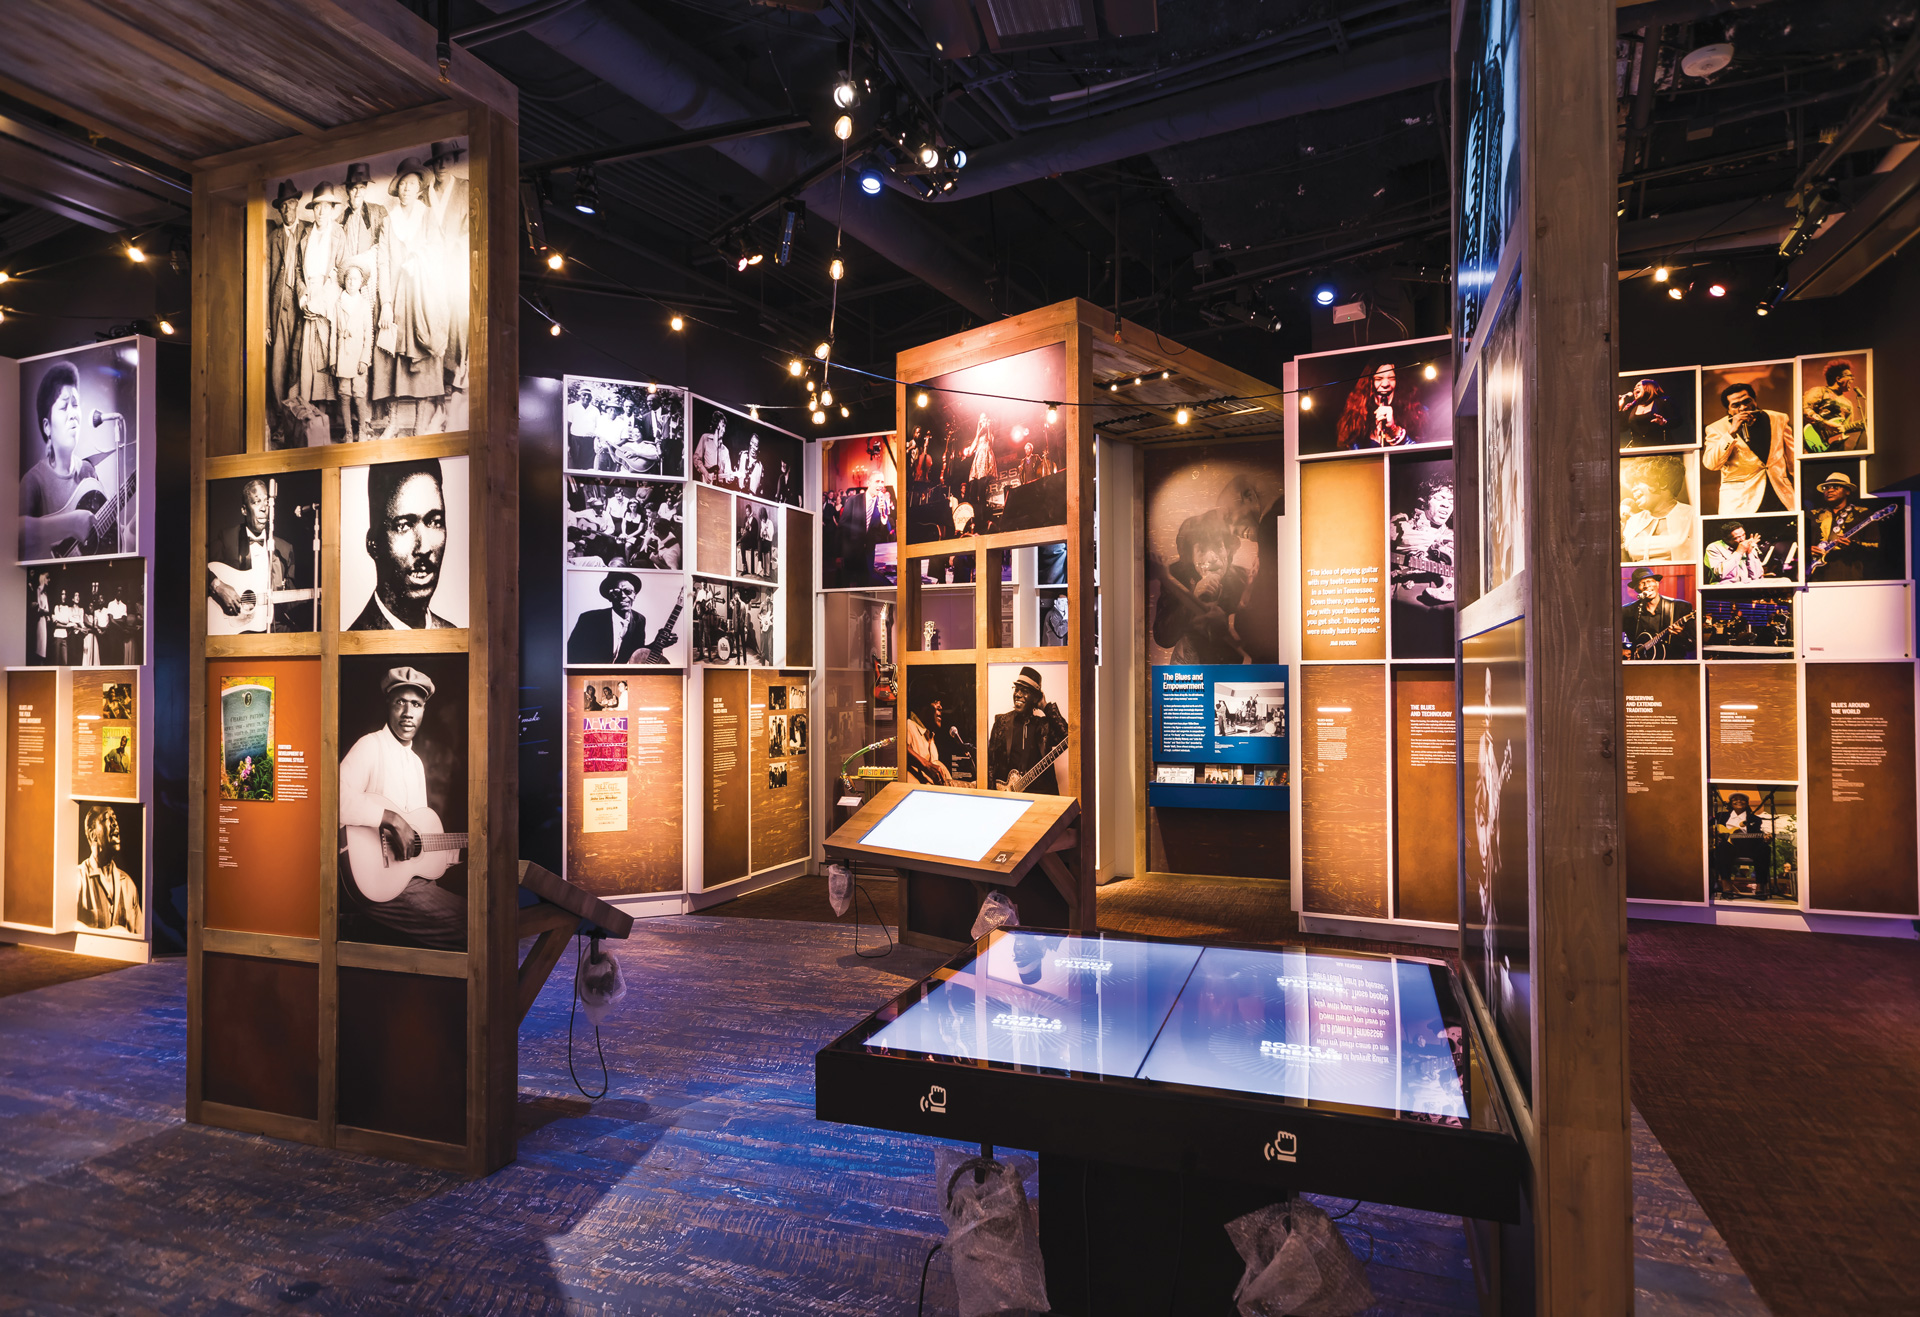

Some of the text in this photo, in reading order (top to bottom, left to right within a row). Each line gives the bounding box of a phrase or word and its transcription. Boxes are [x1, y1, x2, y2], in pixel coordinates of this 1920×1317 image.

[1307, 568, 1320, 576] "The
[1333, 567, 1340, 575] of
[1340, 567, 1361, 576] playing
[1361, 566, 1379, 575] guitar
[1307, 578, 1320, 586] with
[1320, 579, 1329, 587] my
[1330, 577, 1345, 585] teeth
[1311, 588, 1317, 596] in
[1343, 586, 1375, 594] Tennessee.
[1326, 597, 1344, 605] there,
[1343, 597, 1355, 606] you
[1355, 596, 1369, 604] have
[1369, 595, 1376, 603] to
[1306, 608, 1318, 617] play
[1318, 607, 1331, 615] with
[1331, 607, 1345, 616] your
[1345, 606, 1361, 614] teeth
[1368, 605, 1380, 613] else
[1307, 615, 1380, 627] you get shot. Those people
[1320, 627, 1337, 636] really
[1336, 626, 1350, 634] hard
[1350, 626, 1358, 634] to
[1357, 625, 1381, 635] please."
[1162, 672, 1204, 681] The Blues and
[1162, 681, 1205, 692] Empowerment
[585, 717, 627, 730] NEWPORT
[995, 1013, 1048, 1023] ROOTS
[990, 1018, 1063, 1030] STREAMS
[1261, 1040, 1322, 1052] ROOTS
